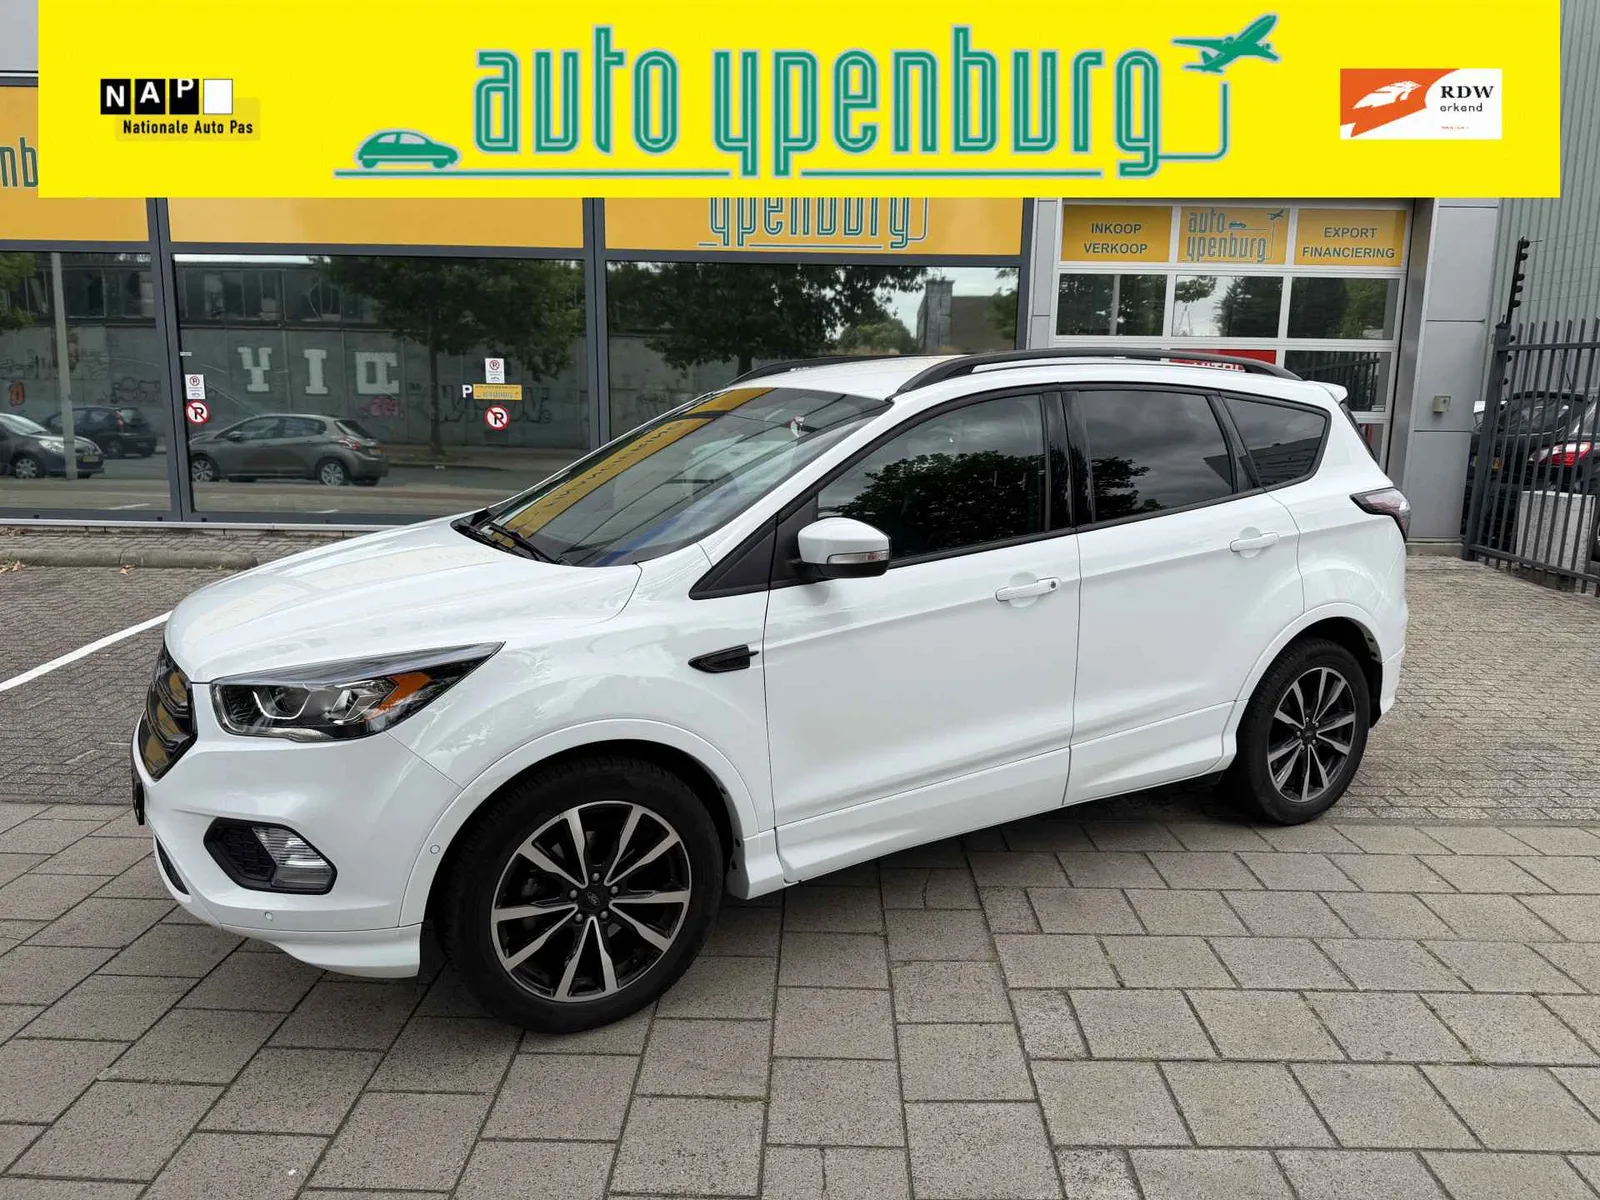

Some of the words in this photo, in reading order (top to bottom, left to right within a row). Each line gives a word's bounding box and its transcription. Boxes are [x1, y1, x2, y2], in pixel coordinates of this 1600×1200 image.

[1187, 208, 1226, 233] auto
[1090, 222, 1143, 235] INKOOP
[1323, 226, 1378, 239] EXPORT
[1083, 242, 1148, 255] VERKOOP
[1187, 233, 1266, 263] ypenburg
[1302, 246, 1395, 259] FINANCIERING
[462, 385, 472, 398] P
